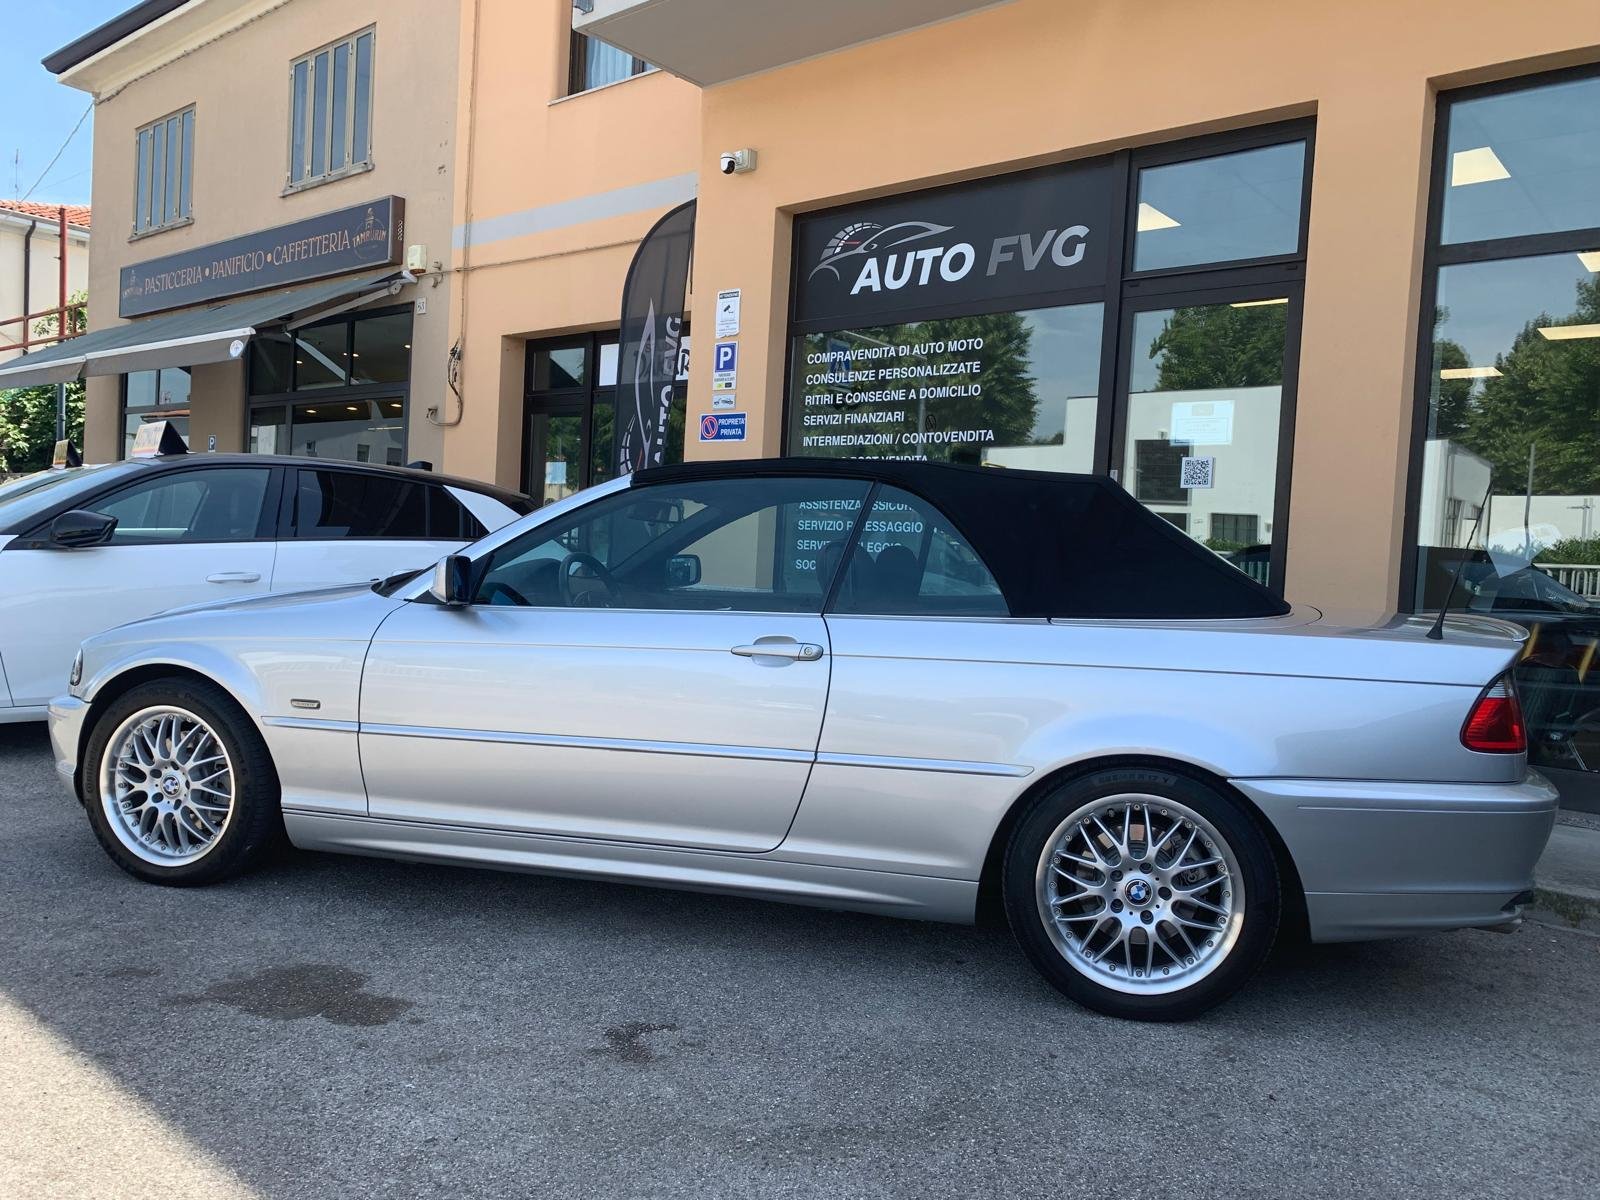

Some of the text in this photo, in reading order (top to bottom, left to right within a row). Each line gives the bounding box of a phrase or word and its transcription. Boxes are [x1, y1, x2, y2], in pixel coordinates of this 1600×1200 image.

[144, 266, 203, 295] PASTICCERIA
[211, 250, 265, 280] PANIFICIO
[272, 229, 351, 266] CAFFETTERIA
[850, 224, 1090, 295] AUTO FVG
[719, 347, 732, 369] P
[807, 338, 984, 364] COMPRAVENDITA DI AUTO MOTO
[806, 361, 981, 385] CONSULENZE PERSONALIZZATE
[805, 384, 981, 406] RITIRI E CONSEGNE A DOMICILIO
[803, 411, 905, 426] SERVIZI FINANZIARI
[720, 428, 742, 436] PRIVATA
[803, 430, 995, 447] INTERMEDIAZIONI / CONTOVENDITA
[799, 499, 861, 511] ASSISTENZA
[798, 520, 844, 531] SERVIZIO
